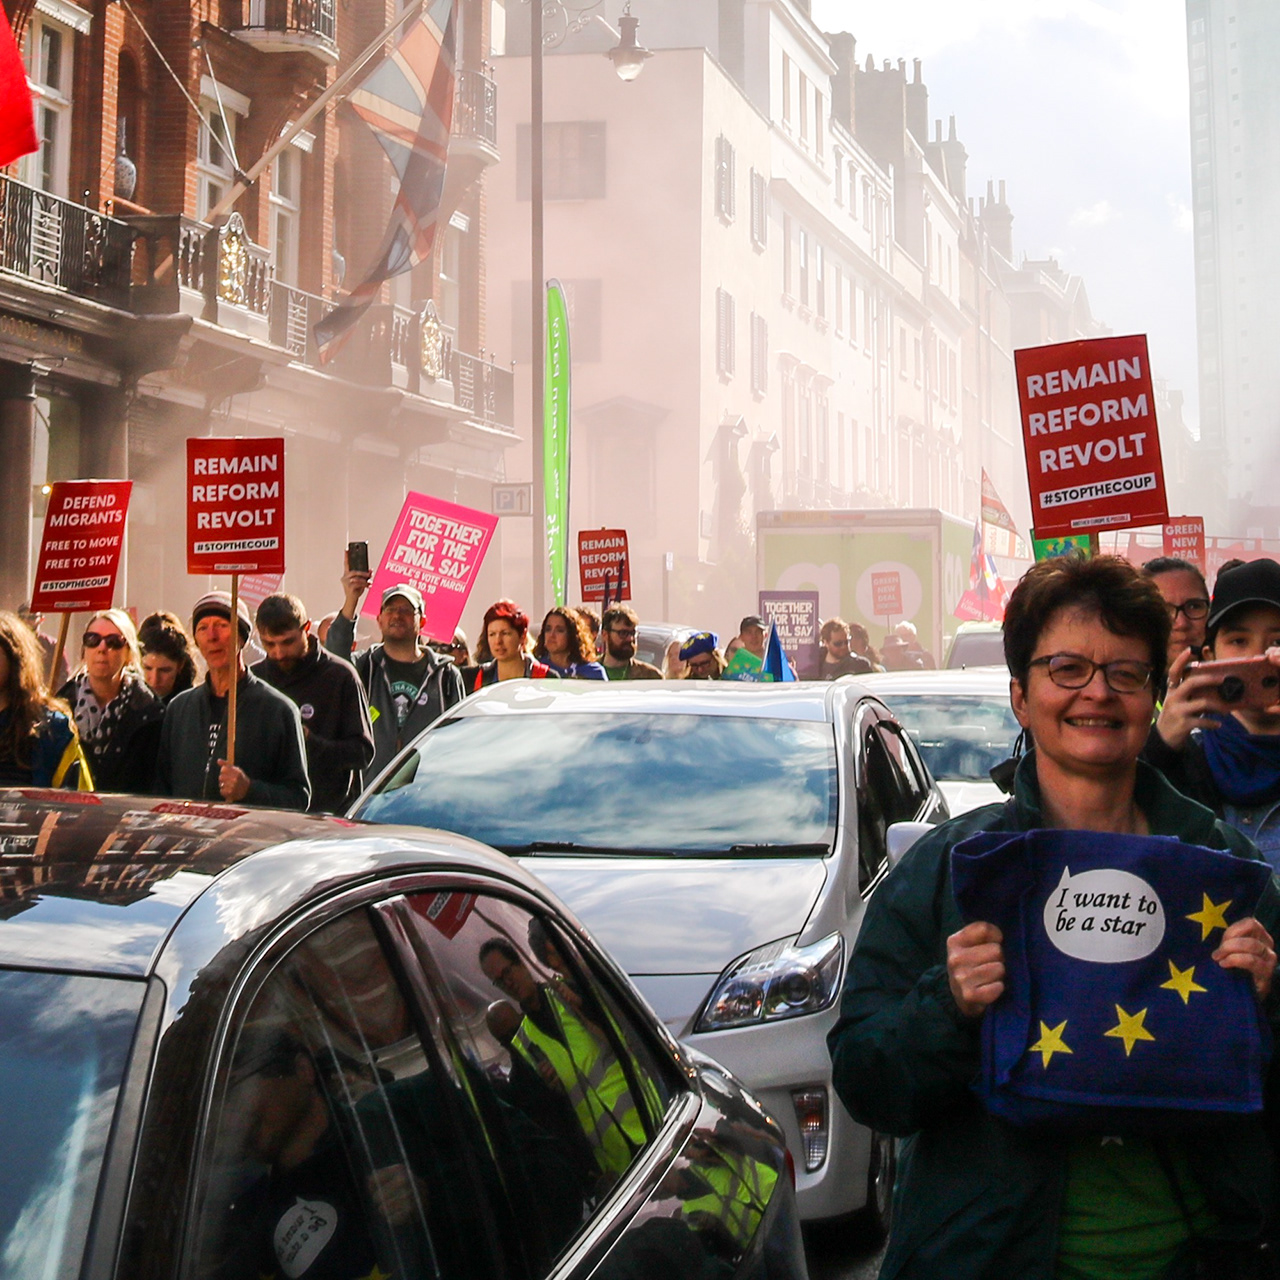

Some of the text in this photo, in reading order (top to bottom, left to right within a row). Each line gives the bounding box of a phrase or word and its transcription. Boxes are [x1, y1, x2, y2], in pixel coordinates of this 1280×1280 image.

[1027, 356, 1141, 399] REMAIN
[1029, 393, 1149, 437] REFORM
[1039, 432, 1147, 473] REVOLT
[194, 454, 278, 475] REMAIN
[192, 481, 279, 502] REFORM
[1044, 476, 1152, 504] #STOPTHECOUP
[63, 494, 116, 510] DEFEND
[50, 510, 122, 527] MIGRANTS
[197, 508, 276, 529] REVOLT
[409, 510, 483, 546] TOGETHER
[1166, 524, 1202, 535] GREEN
[45, 536, 119, 551] FREE TO MOVE
[197, 539, 276, 551] #STOPTHECOUP
[406, 529, 471, 562] FOR THE
[581, 537, 625, 550] REMAIN
[1172, 537, 1198, 548] NEW
[45, 554, 113, 570] FREE TO STAY
[393, 545, 471, 580] FINAL SAY
[581, 552, 626, 565] REFORM
[1172, 549, 1198, 559] DEAL
[42, 577, 108, 590] #STOPTHECOUP
[385, 562, 466, 593] PEOPLE'S VOTE MARCH
[765, 602, 812, 613] TOGETHER
[791, 614, 809, 625] THE
[794, 625, 813, 637] SAY
[1056, 888, 1157, 915] I want to
[1056, 909, 1147, 936] be a star
